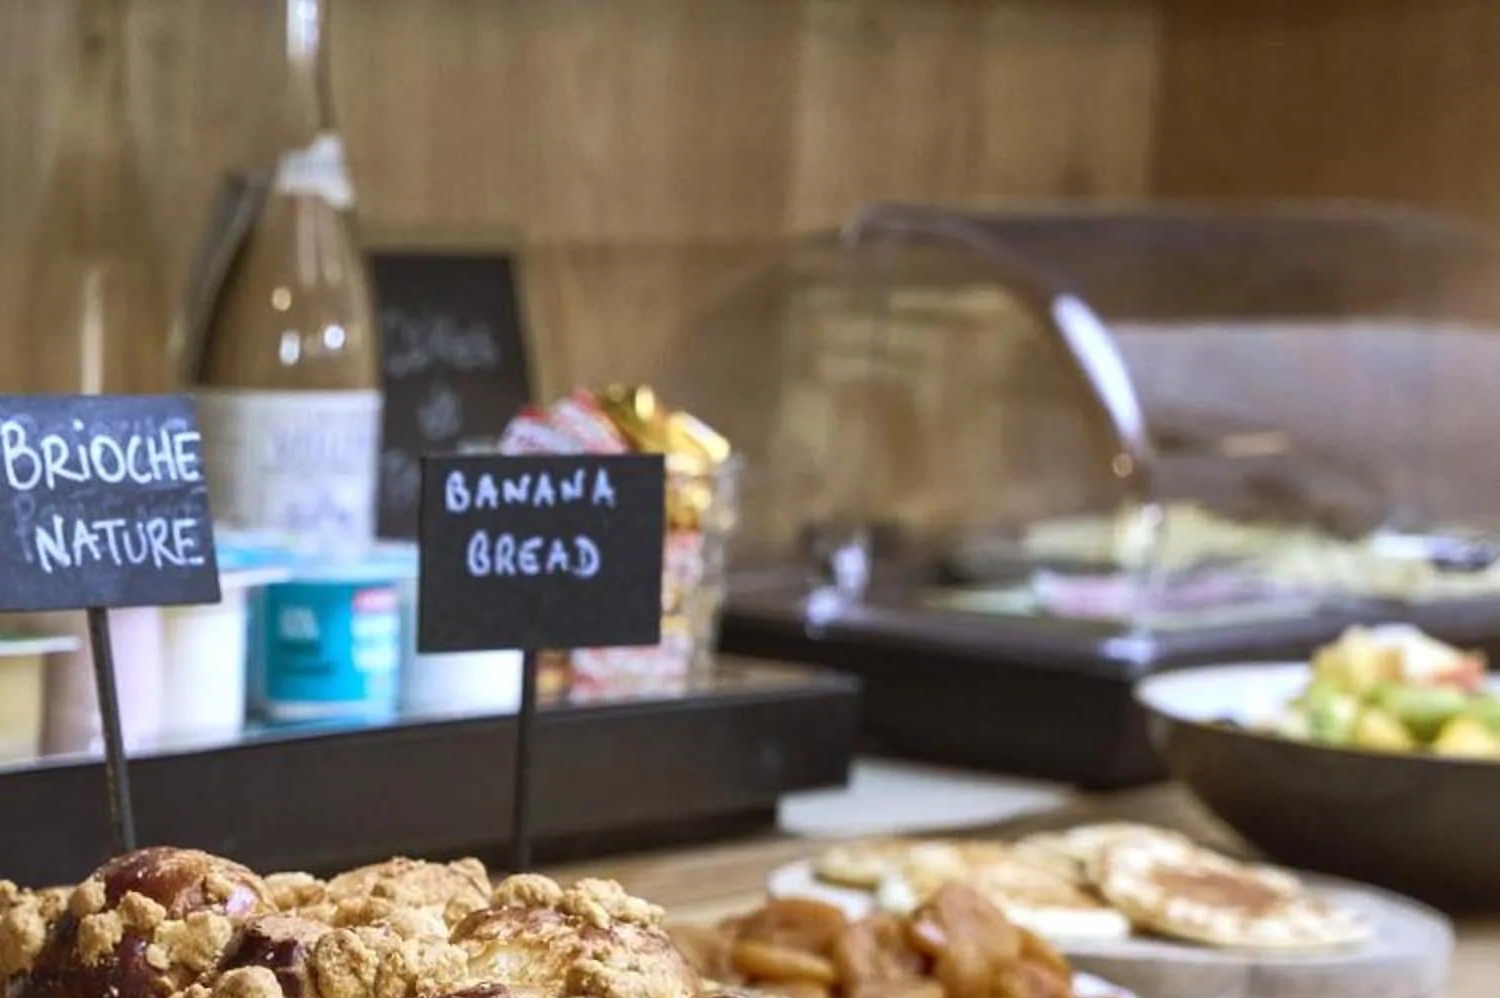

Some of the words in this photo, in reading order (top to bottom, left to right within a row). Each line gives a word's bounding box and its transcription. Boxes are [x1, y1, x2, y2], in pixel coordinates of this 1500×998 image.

[445, 467, 616, 514] BANANA
[35, 514, 205, 574] NATURE
[467, 528, 601, 580] BREAD
